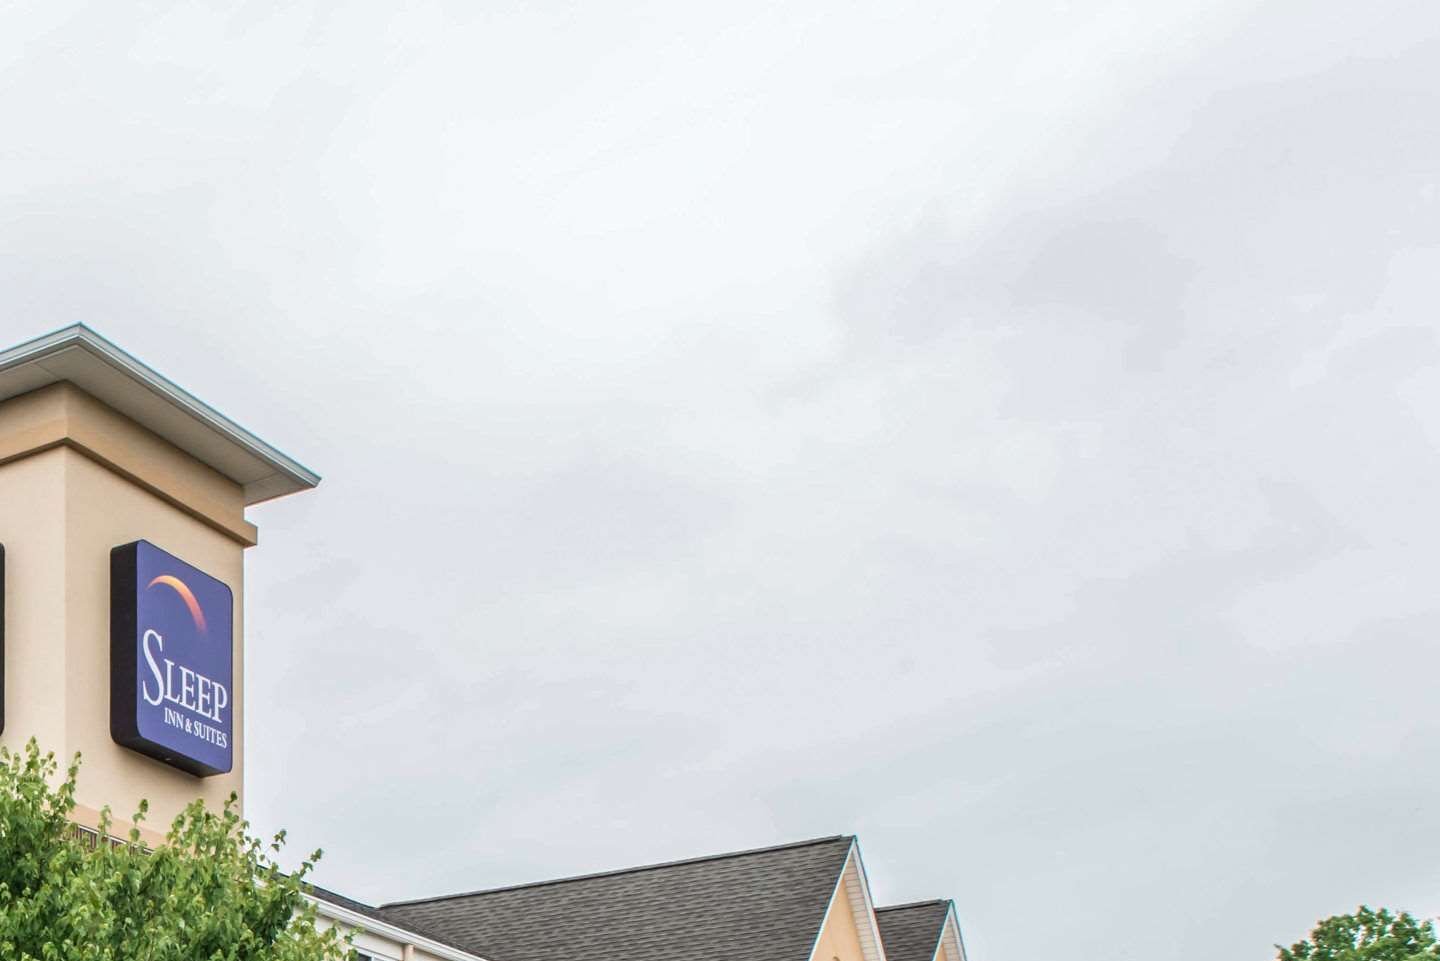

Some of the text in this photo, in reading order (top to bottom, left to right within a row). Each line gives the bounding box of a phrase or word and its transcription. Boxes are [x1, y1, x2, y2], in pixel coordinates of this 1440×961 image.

[143, 629, 228, 723] SLEEP
[164, 707, 228, 749] INN & SUITES
